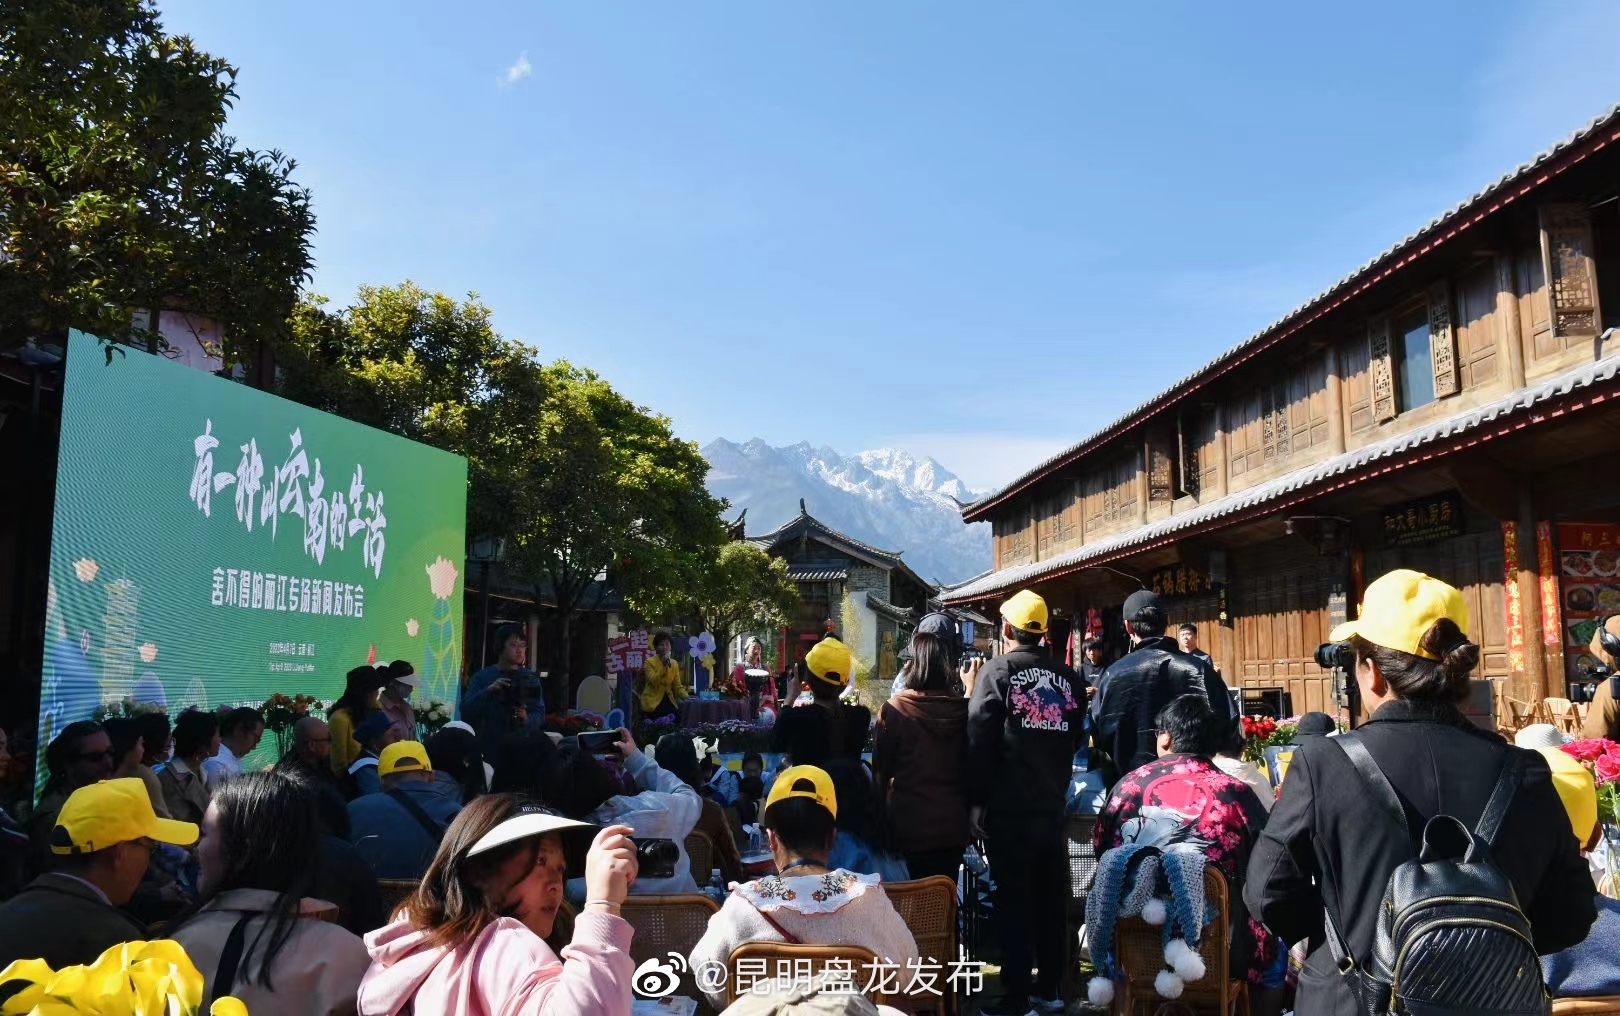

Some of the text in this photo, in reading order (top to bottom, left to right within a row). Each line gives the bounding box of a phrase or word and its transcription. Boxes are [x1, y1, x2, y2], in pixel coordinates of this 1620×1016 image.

[189, 418, 387, 580] 有一种叫云南的生活
[211, 566, 364, 618] 舍不得的丽江专场新闻发布会
[610, 630, 648, 652] 一起
[1021, 717, 1069, 732] ICONSLAB
